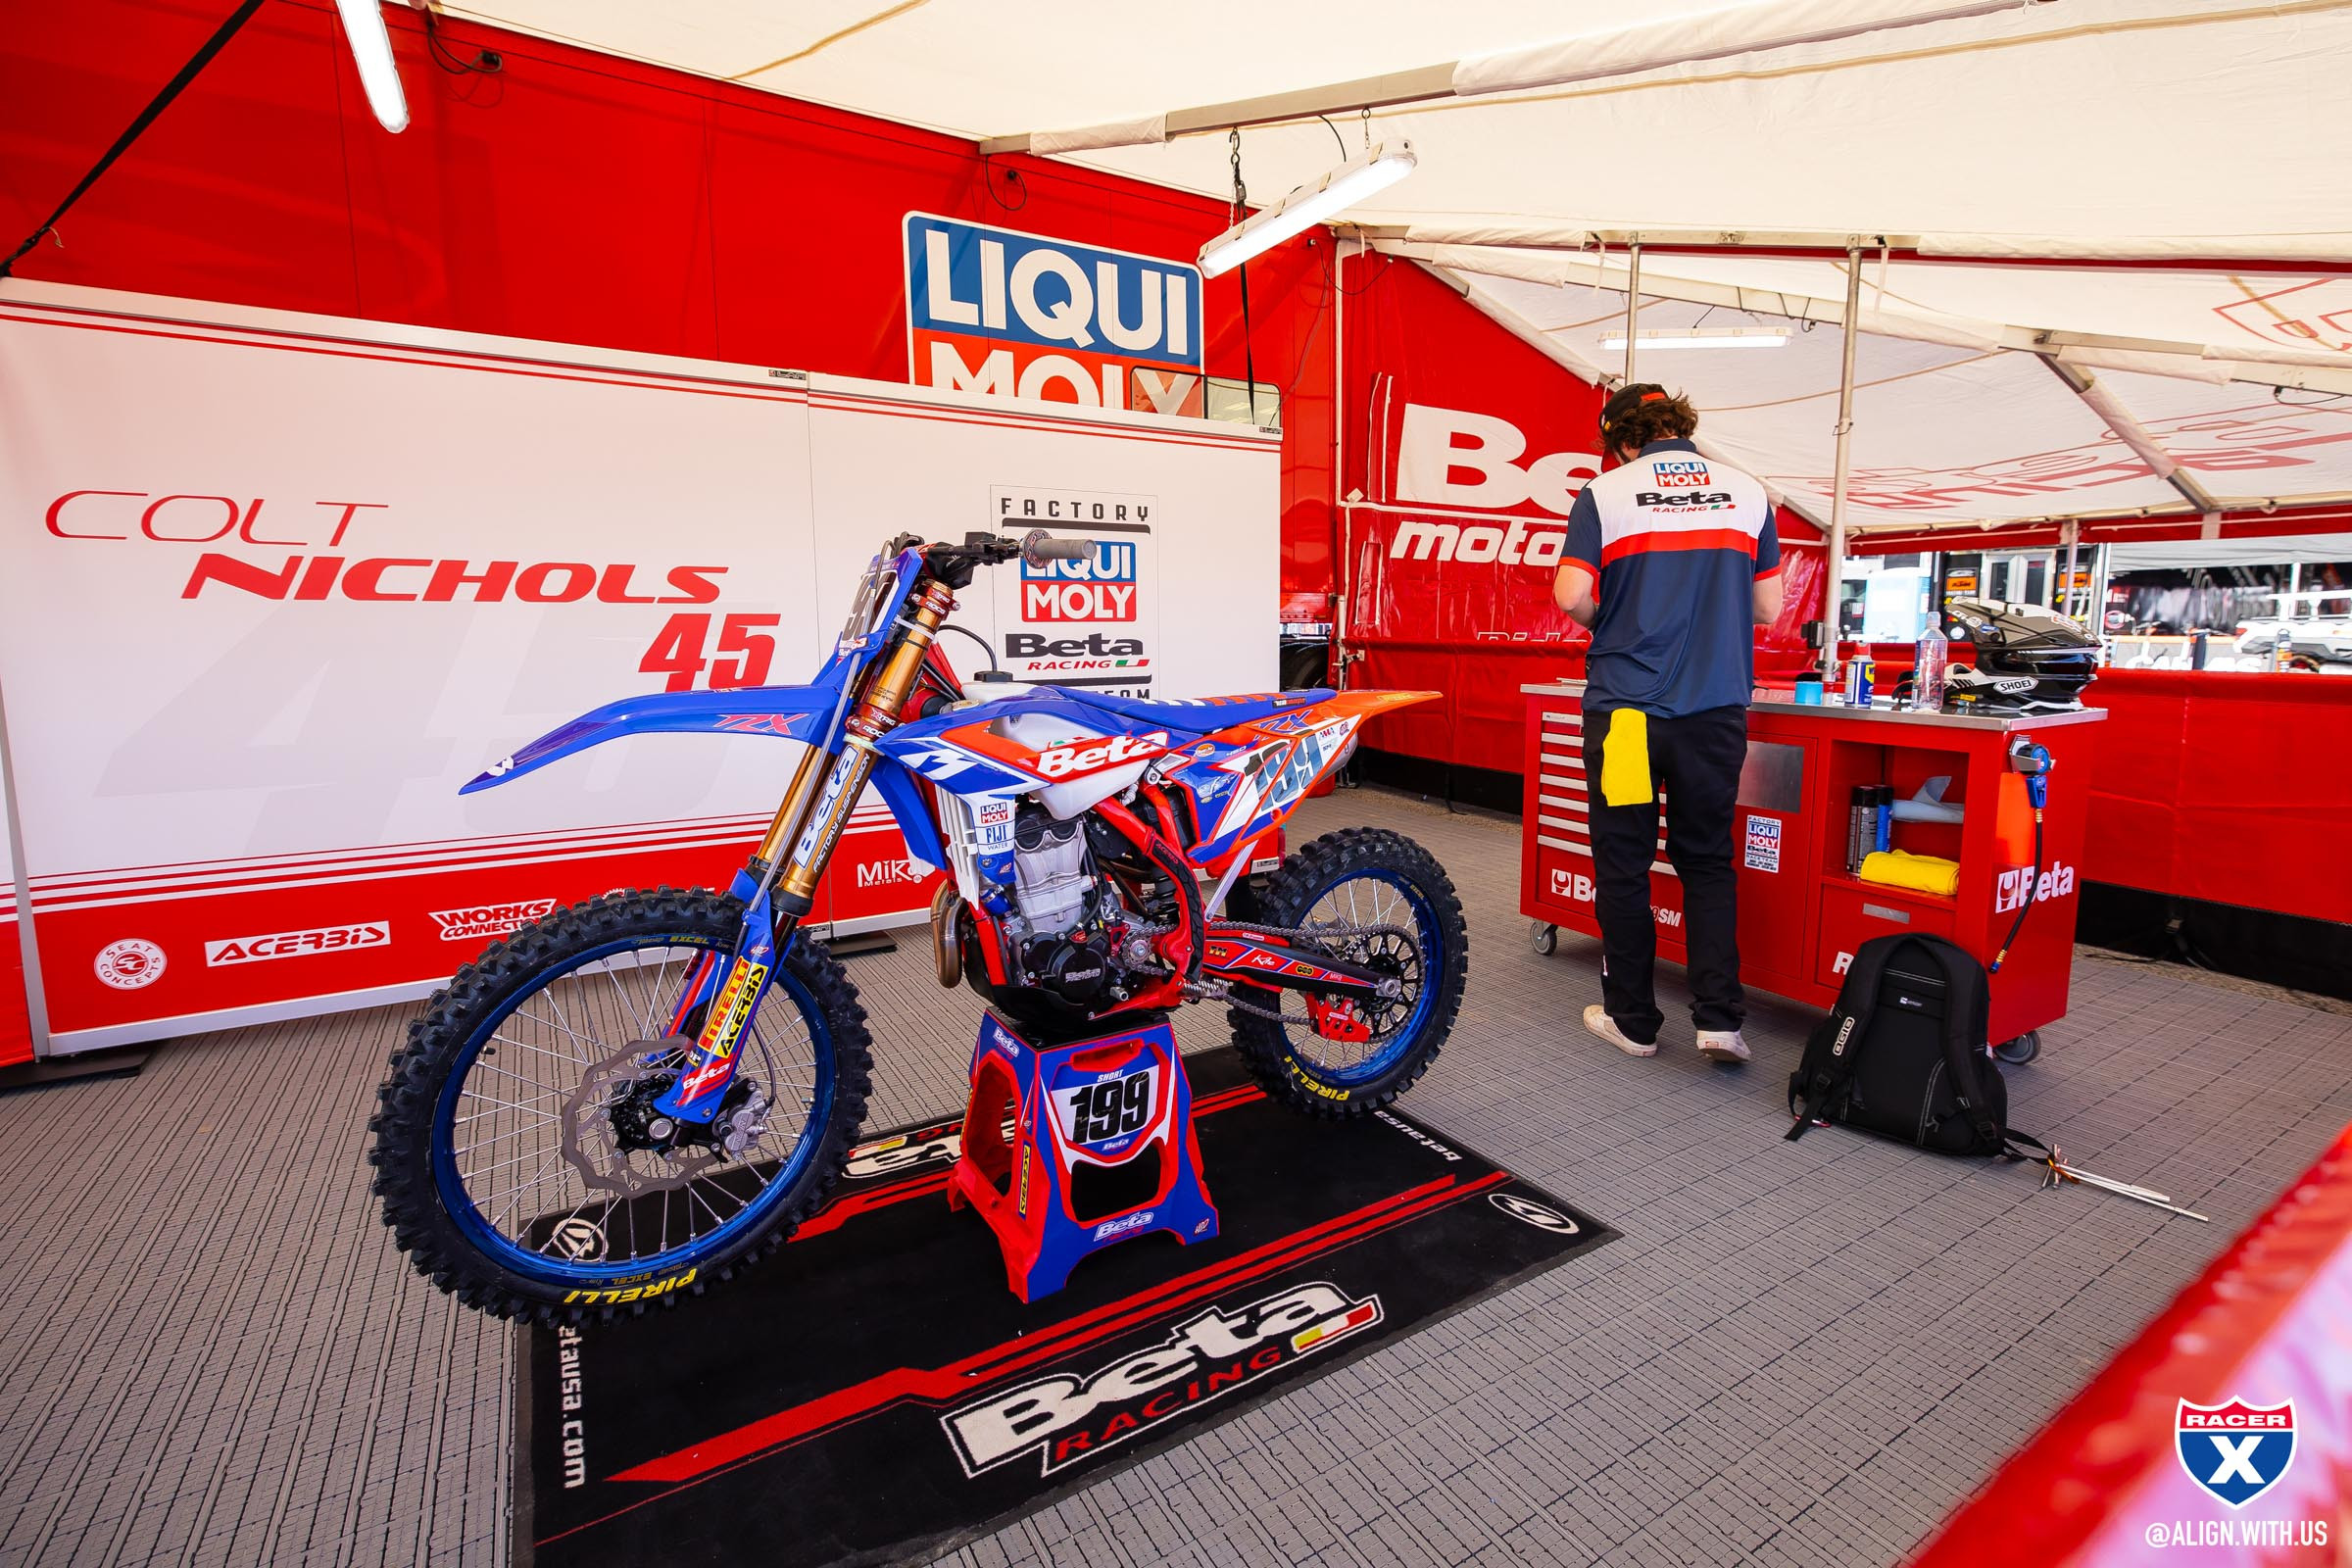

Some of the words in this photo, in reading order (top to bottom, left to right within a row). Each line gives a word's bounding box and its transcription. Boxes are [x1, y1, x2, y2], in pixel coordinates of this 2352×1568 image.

[925, 229, 1188, 356] LIQUI
[1396, 403, 1601, 514] Be
[1655, 463, 1705, 474] LIQUI
[1658, 473, 1708, 486] MOLY
[1001, 497, 1149, 521] FACTORY
[1636, 491, 1732, 507] Beta
[45, 490, 389, 548] COLT
[181, 553, 729, 604] NICHOLS
[1026, 584, 1135, 619] MOLY
[639, 613, 781, 692] 45
[1005, 633, 1143, 659] Beta
[1028, 660, 1111, 670] RACING
[2000, 679, 2033, 691] SHOEI
[863, 725, 885, 737] ROC
[1037, 731, 1168, 777] Beta
[793, 744, 859, 870] Beta
[813, 821, 838, 872] FACTORY
[837, 753, 871, 826] SUSPENSION
[981, 802, 1006, 814] LIQUI
[982, 811, 1007, 823] MOLY
[986, 825, 1006, 843] FIJI
[1748, 834, 1778, 848] MOLY
[1749, 823, 1779, 838] LIQUI
[2018, 860, 2075, 907] Beta
[436, 902, 550, 927] WORKS
[106, 942, 153, 959] SEAT
[99, 956, 162, 987] CONCEPTS
[993, 1026, 1019, 1057] Beta
[1833, 1016, 1855, 1056] OGIO
[683, 1063, 731, 1091] Beta
[1098, 1069, 1124, 1082] SHORT
[1284, 1055, 1350, 1102] PIRELLI
[1070, 1071, 1151, 1144] 199
[1095, 1212, 1153, 1241] Beta
[564, 1268, 697, 1304] PIRELLI
[954, 1283, 1348, 1466] Beta
[1055, 1346, 1282, 1462] RACING
